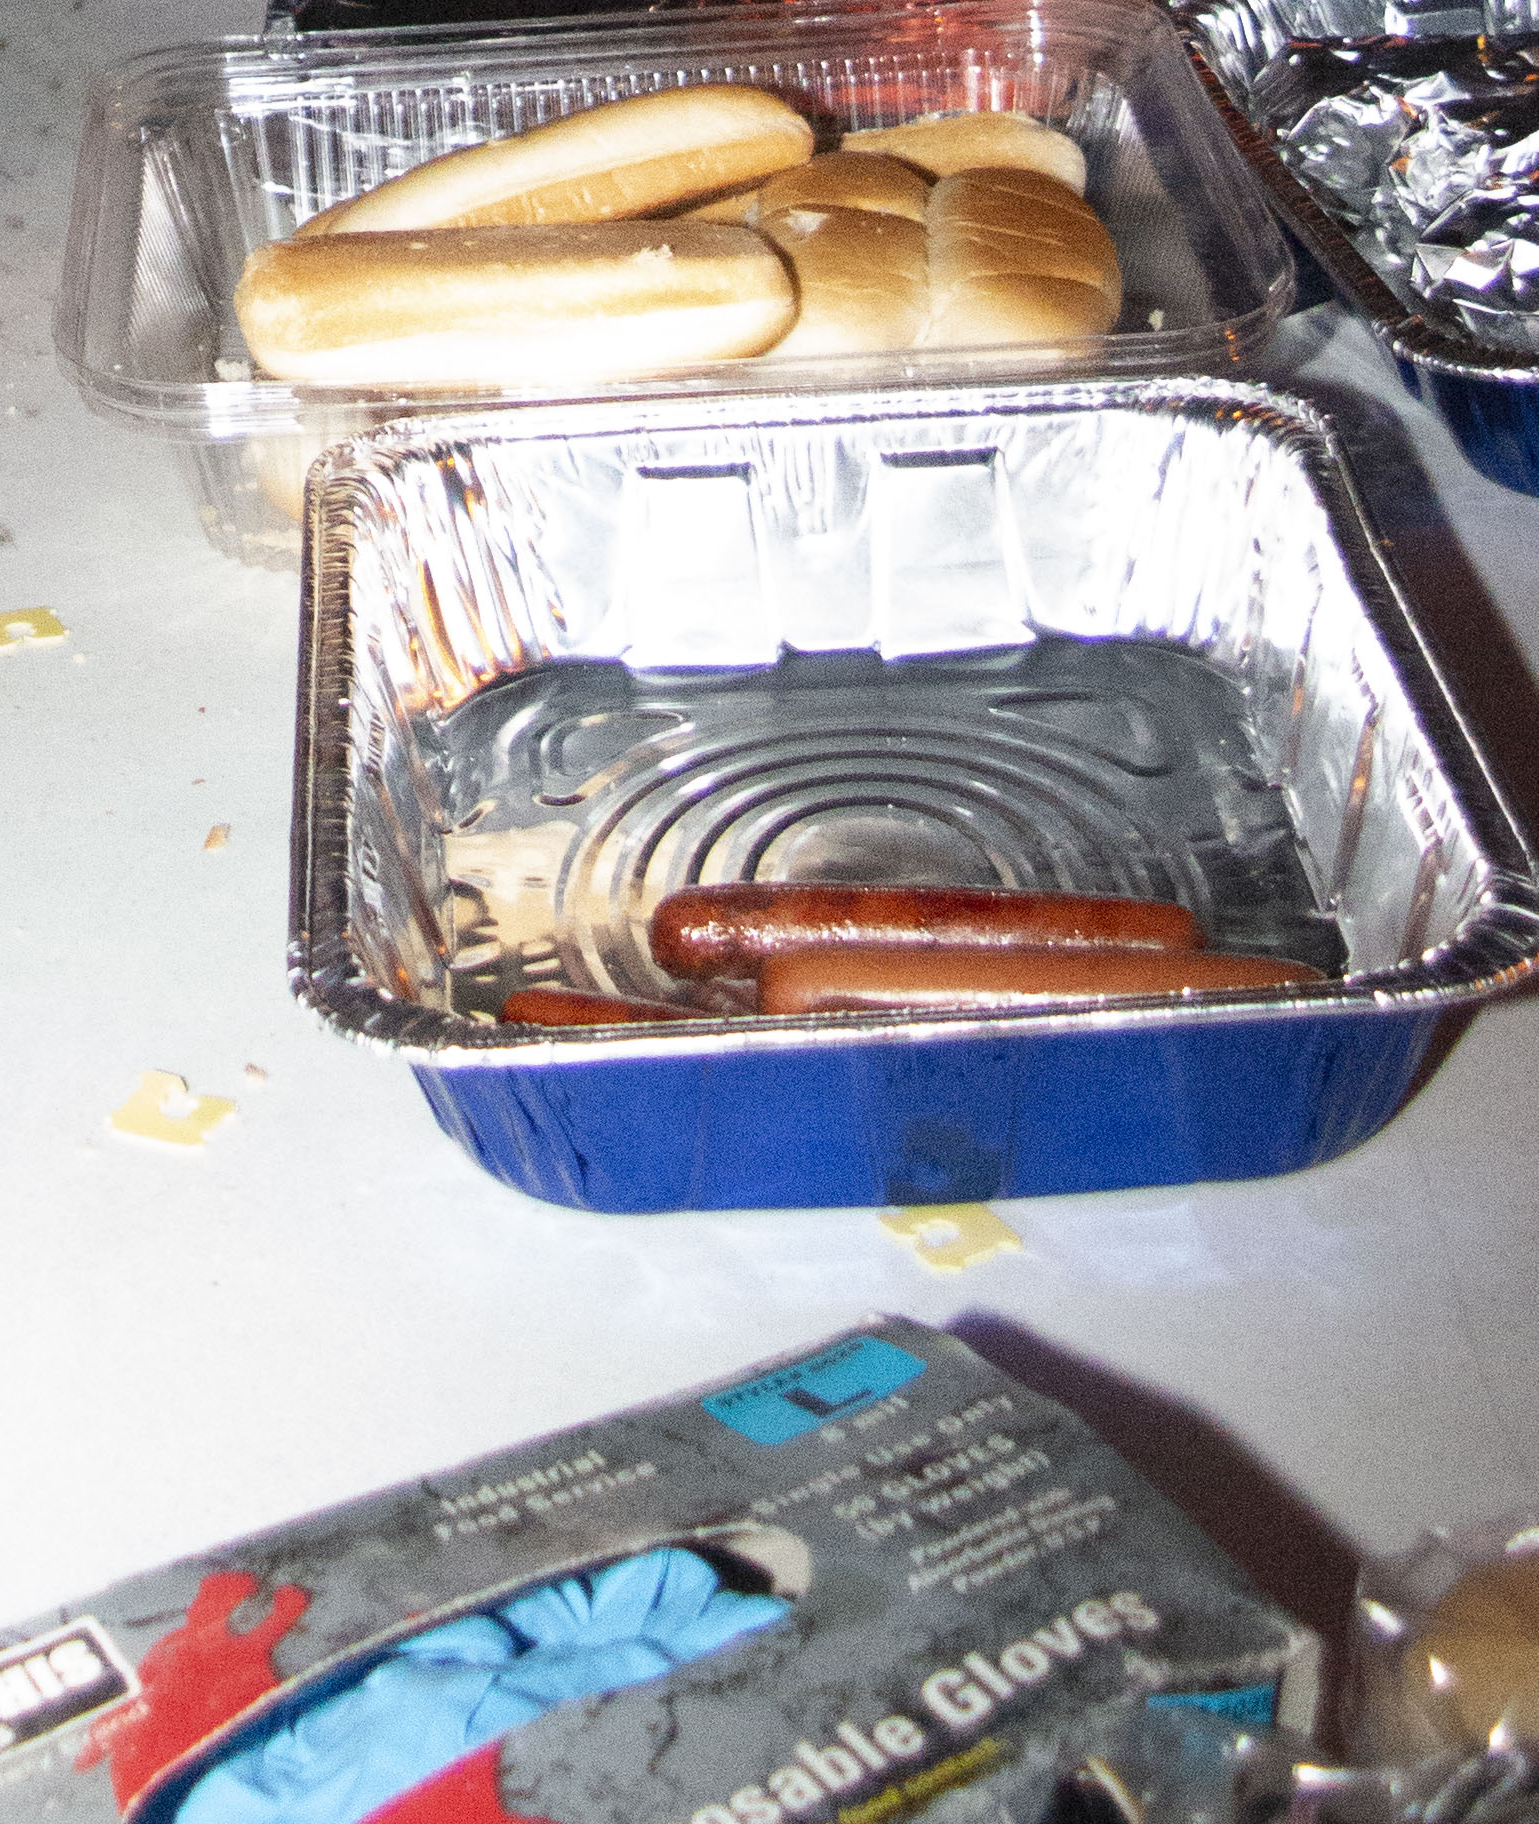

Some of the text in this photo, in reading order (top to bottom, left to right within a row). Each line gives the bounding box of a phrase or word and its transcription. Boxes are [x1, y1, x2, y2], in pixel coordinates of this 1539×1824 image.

[782, 1388, 874, 1417] L
[441, 1450, 605, 1515] Industrial
[751, 1394, 1014, 1516] Single Use Only
[879, 1433, 1016, 1502] GLOVES
[433, 1461, 657, 1541] Food Service
[921, 1591, 1159, 1729] Gloves
